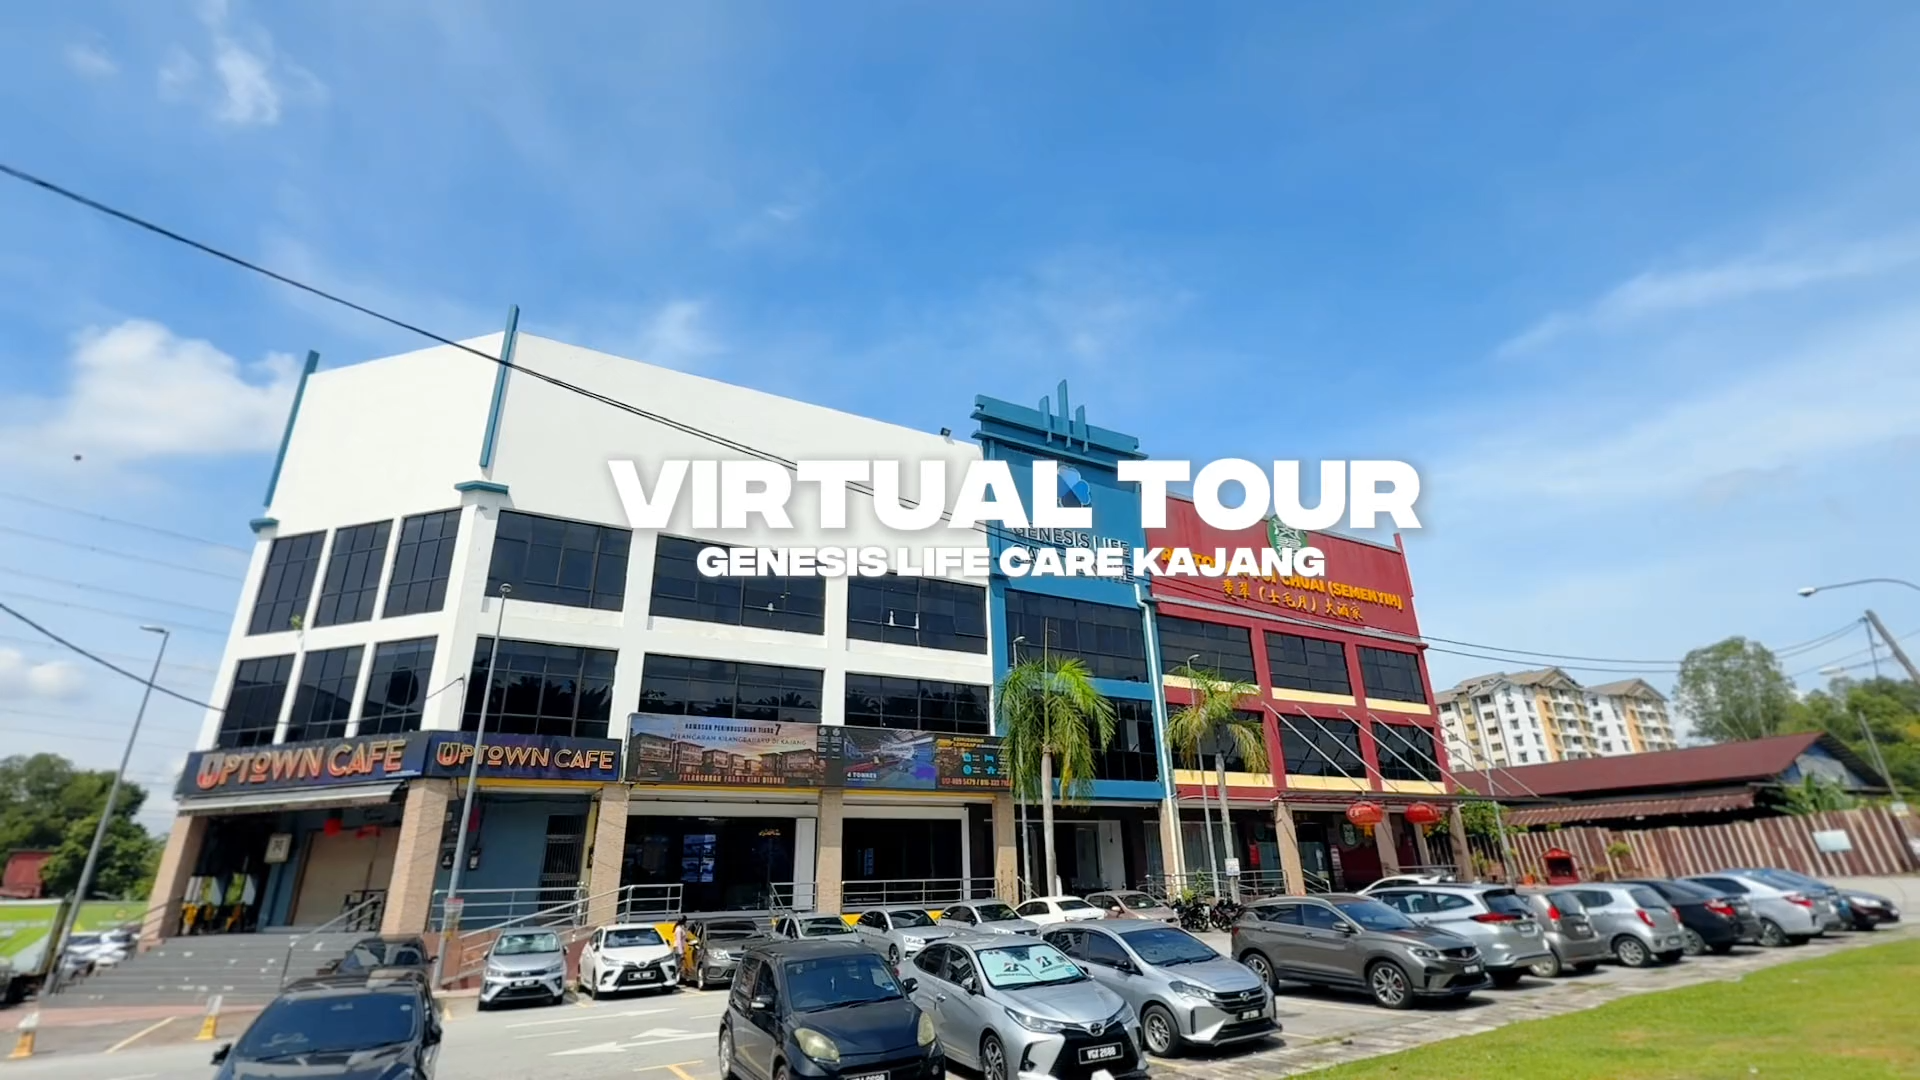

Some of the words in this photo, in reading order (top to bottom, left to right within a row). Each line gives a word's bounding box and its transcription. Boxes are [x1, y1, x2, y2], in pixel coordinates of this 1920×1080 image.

[775, 723, 782, 736] 7
[196, 746, 325, 790] UPTOWN
[327, 738, 406, 777] CAFE
[436, 742, 550, 767] UPTOWN
[553, 749, 615, 770] CAFE
